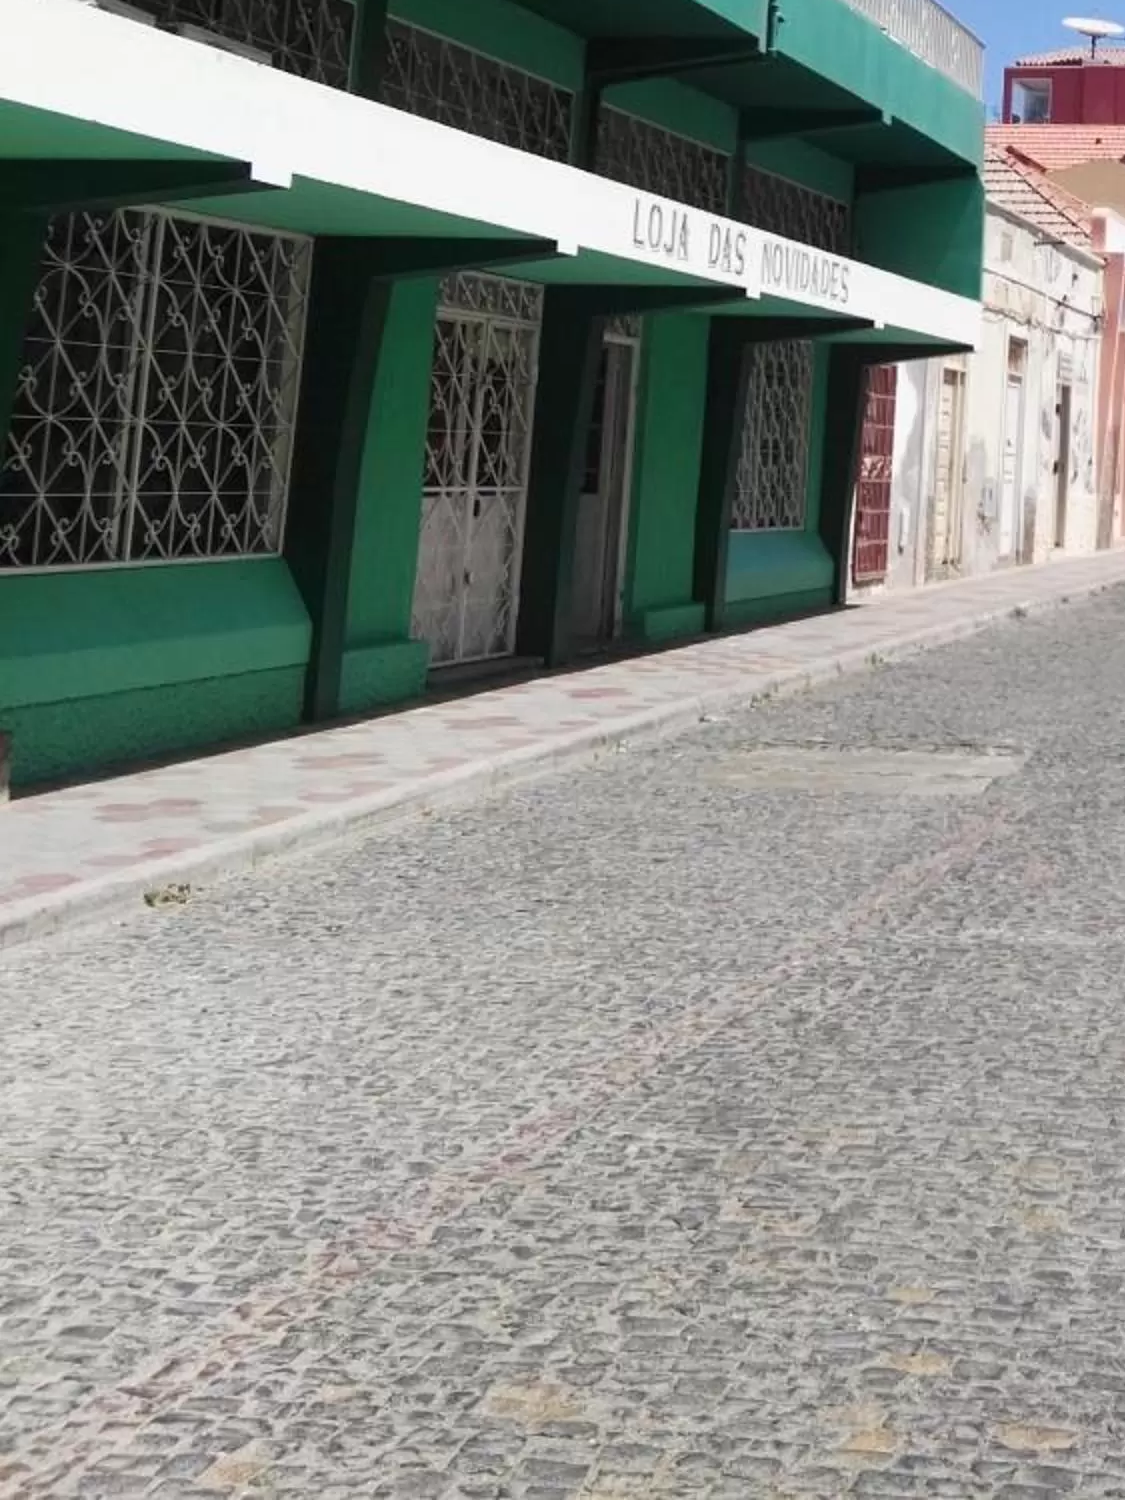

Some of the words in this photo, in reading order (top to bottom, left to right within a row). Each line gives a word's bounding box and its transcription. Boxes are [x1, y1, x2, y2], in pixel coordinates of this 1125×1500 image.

[632, 197, 689, 262] LOJA
[707, 223, 747, 277] DAS
[760, 243, 850, 304] NOVIDADES
